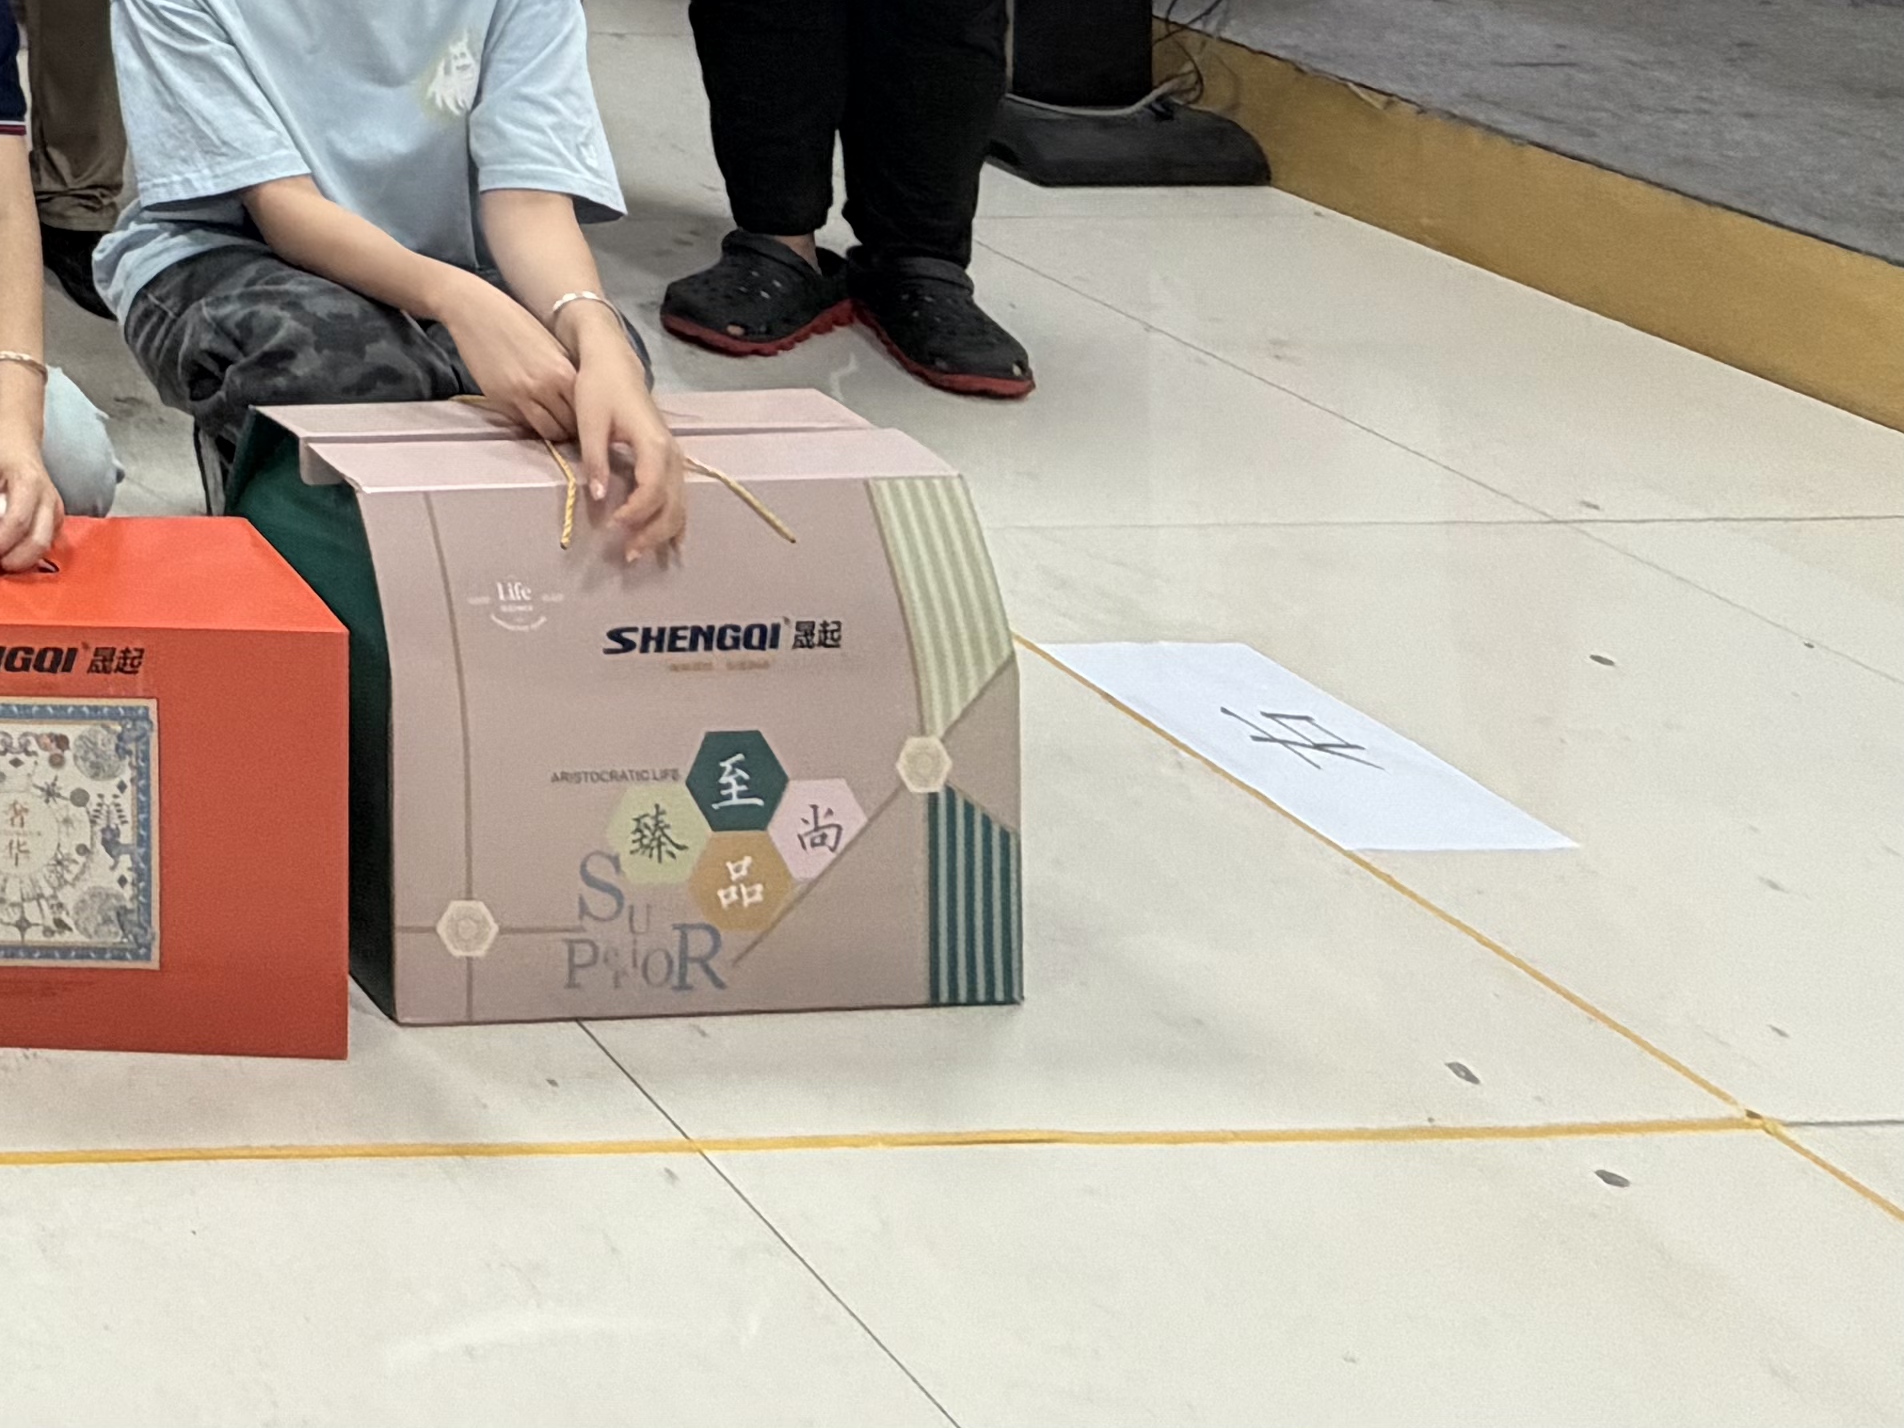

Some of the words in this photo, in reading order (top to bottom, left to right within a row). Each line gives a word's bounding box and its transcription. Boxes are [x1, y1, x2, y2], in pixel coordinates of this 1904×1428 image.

[496, 582, 532, 602] Life
[602, 623, 781, 655] SHENGQI
[791, 619, 843, 650] 晟起
[86, 646, 145, 676] 晟起
[710, 752, 765, 811] 至
[794, 802, 845, 855] 尚
[716, 854, 765, 911] 品
